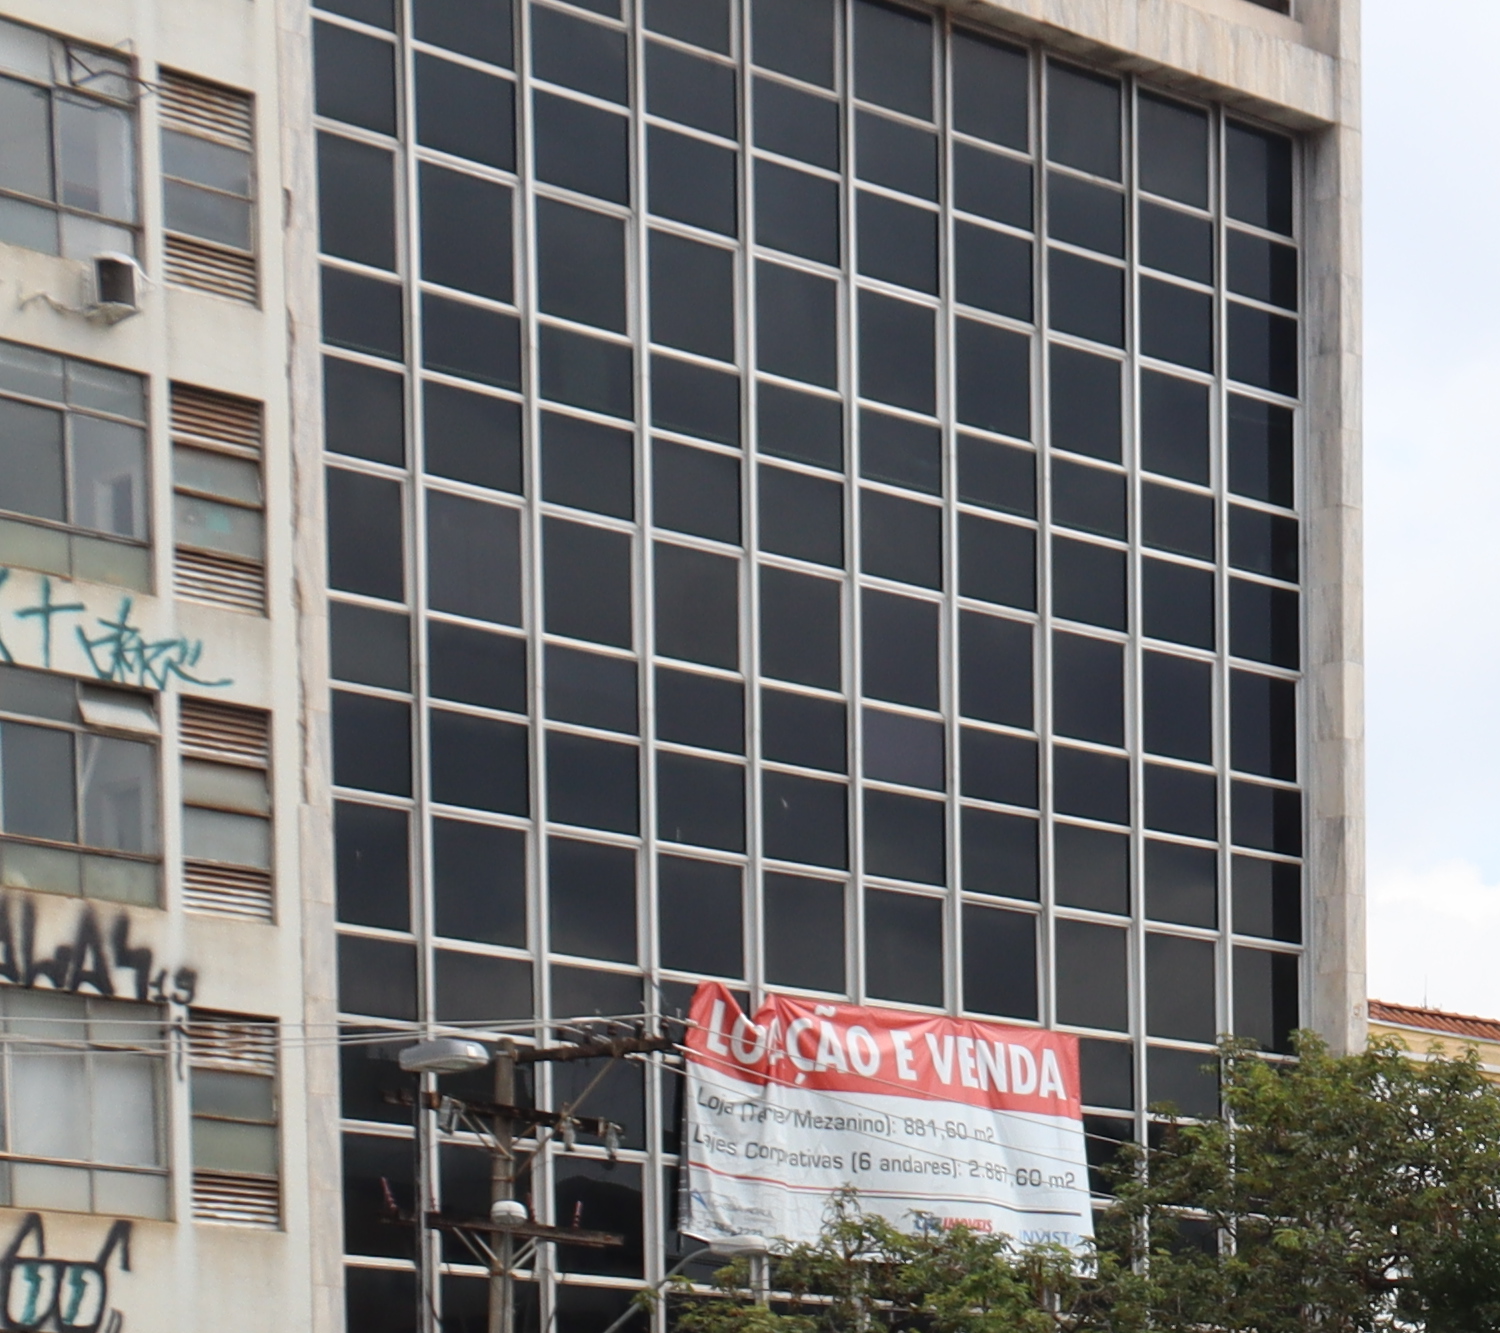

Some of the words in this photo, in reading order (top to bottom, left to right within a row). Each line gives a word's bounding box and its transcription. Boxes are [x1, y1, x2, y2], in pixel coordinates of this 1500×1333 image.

[889, 1029, 918, 1082] E
[925, 1031, 1068, 1101] VENDA
[692, 1123, 737, 1156] Lajes
[851, 1152, 872, 1175] (6
[880, 1154, 962, 1178] andares):
[1049, 1171, 1076, 1189] m2
[974, 1125, 995, 1142] m2
